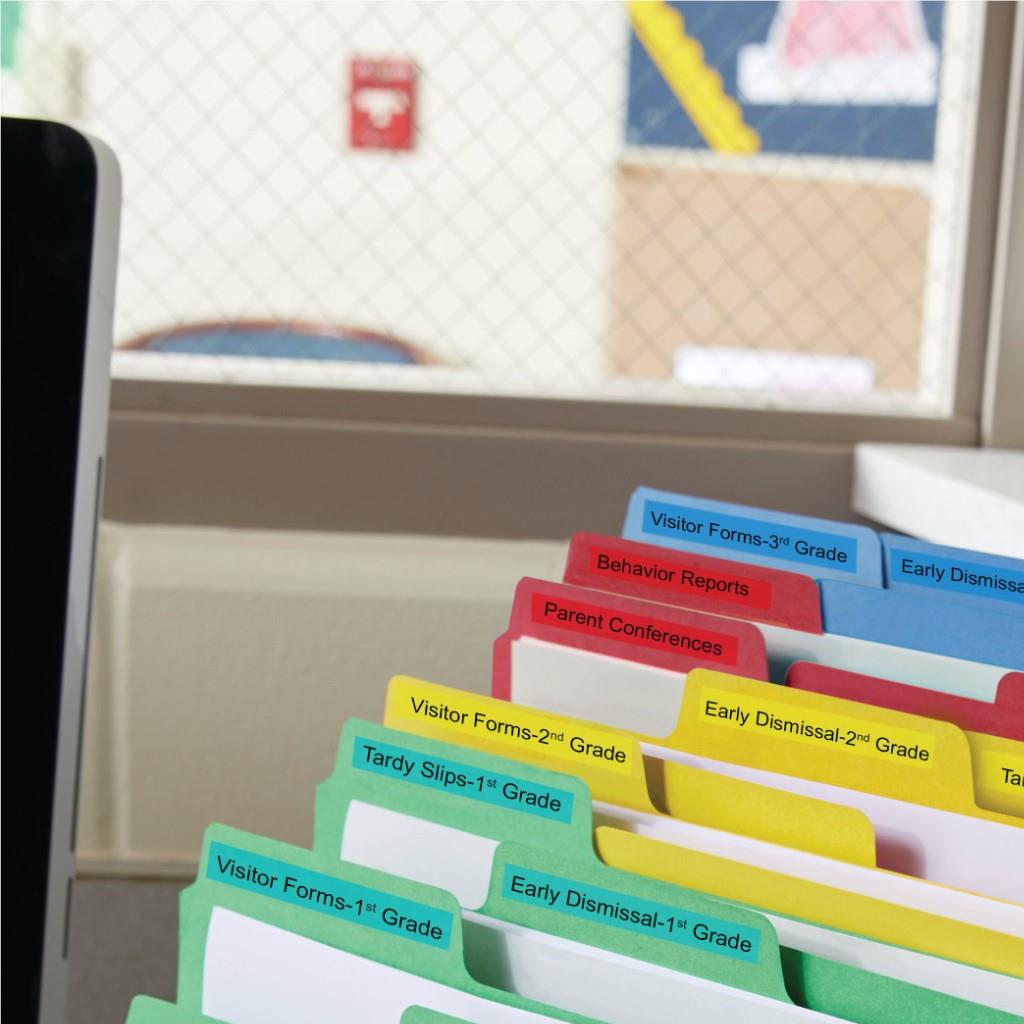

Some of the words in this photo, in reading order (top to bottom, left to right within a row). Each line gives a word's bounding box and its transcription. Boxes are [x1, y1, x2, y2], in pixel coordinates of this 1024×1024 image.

[650, 511, 704, 535] Visitor
[794, 540, 848, 563] Grade
[597, 554, 676, 582] Behavior
[681, 569, 750, 597] Reports
[901, 558, 945, 582] Early
[544, 601, 604, 630] Parent
[609, 616, 723, 656] Conferences
[410, 697, 469, 725] Visitor
[569, 736, 627, 763] Grade
[704, 700, 750, 727] Early
[875, 737, 930, 762] Grade
[363, 745, 416, 776] Tardy
[502, 782, 562, 812] Grade
[217, 855, 279, 889] Visitor
[381, 907, 443, 940] Grade
[510, 875, 561, 906] Early
[692, 923, 753, 953] Grade
